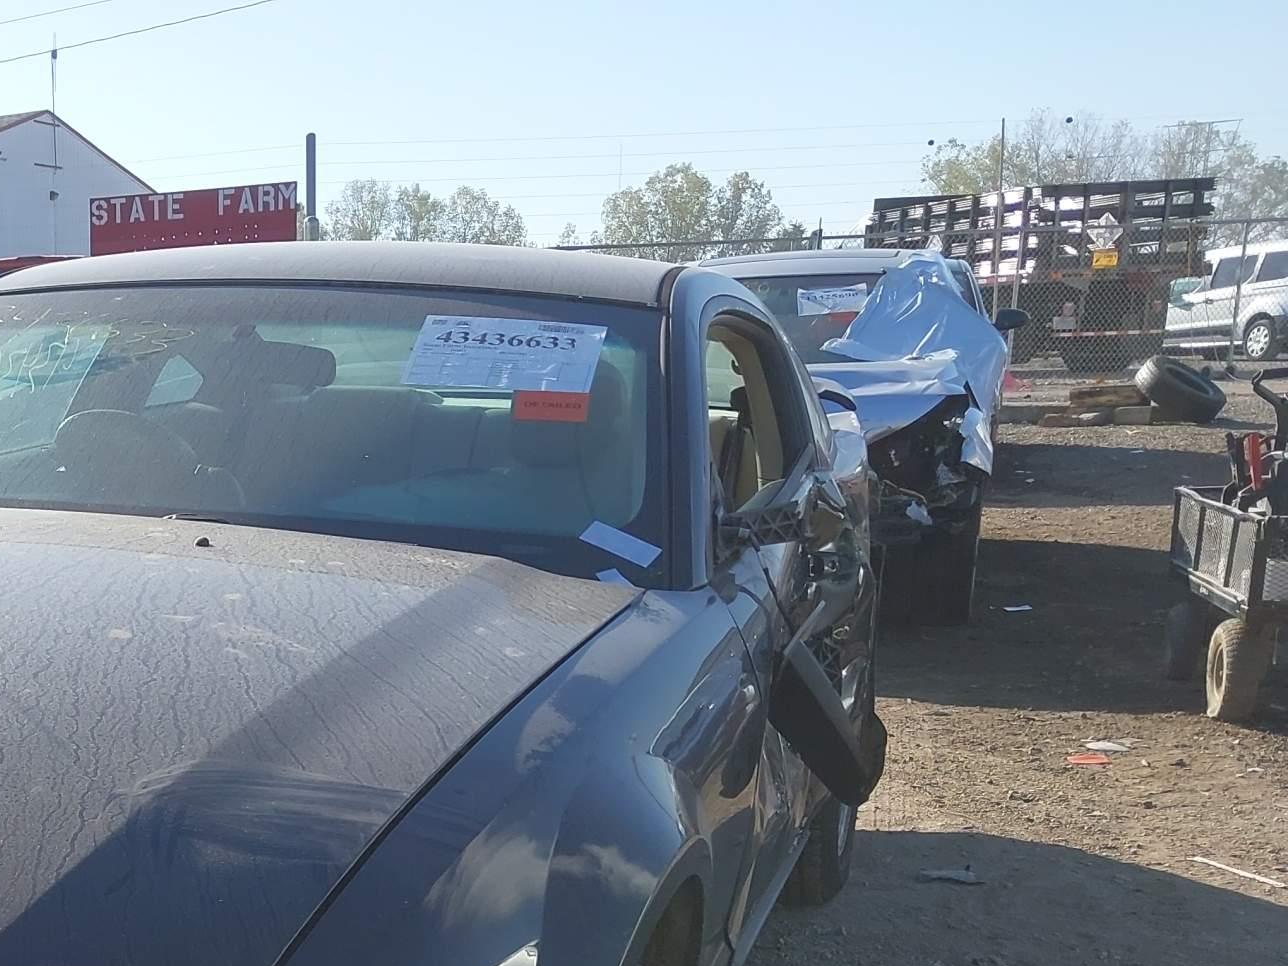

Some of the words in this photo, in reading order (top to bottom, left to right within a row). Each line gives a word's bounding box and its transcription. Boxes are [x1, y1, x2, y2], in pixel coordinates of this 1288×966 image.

[91, 194, 185, 226] STATE
[218, 183, 296, 216] FARM
[435, 329, 577, 351] 43436633
